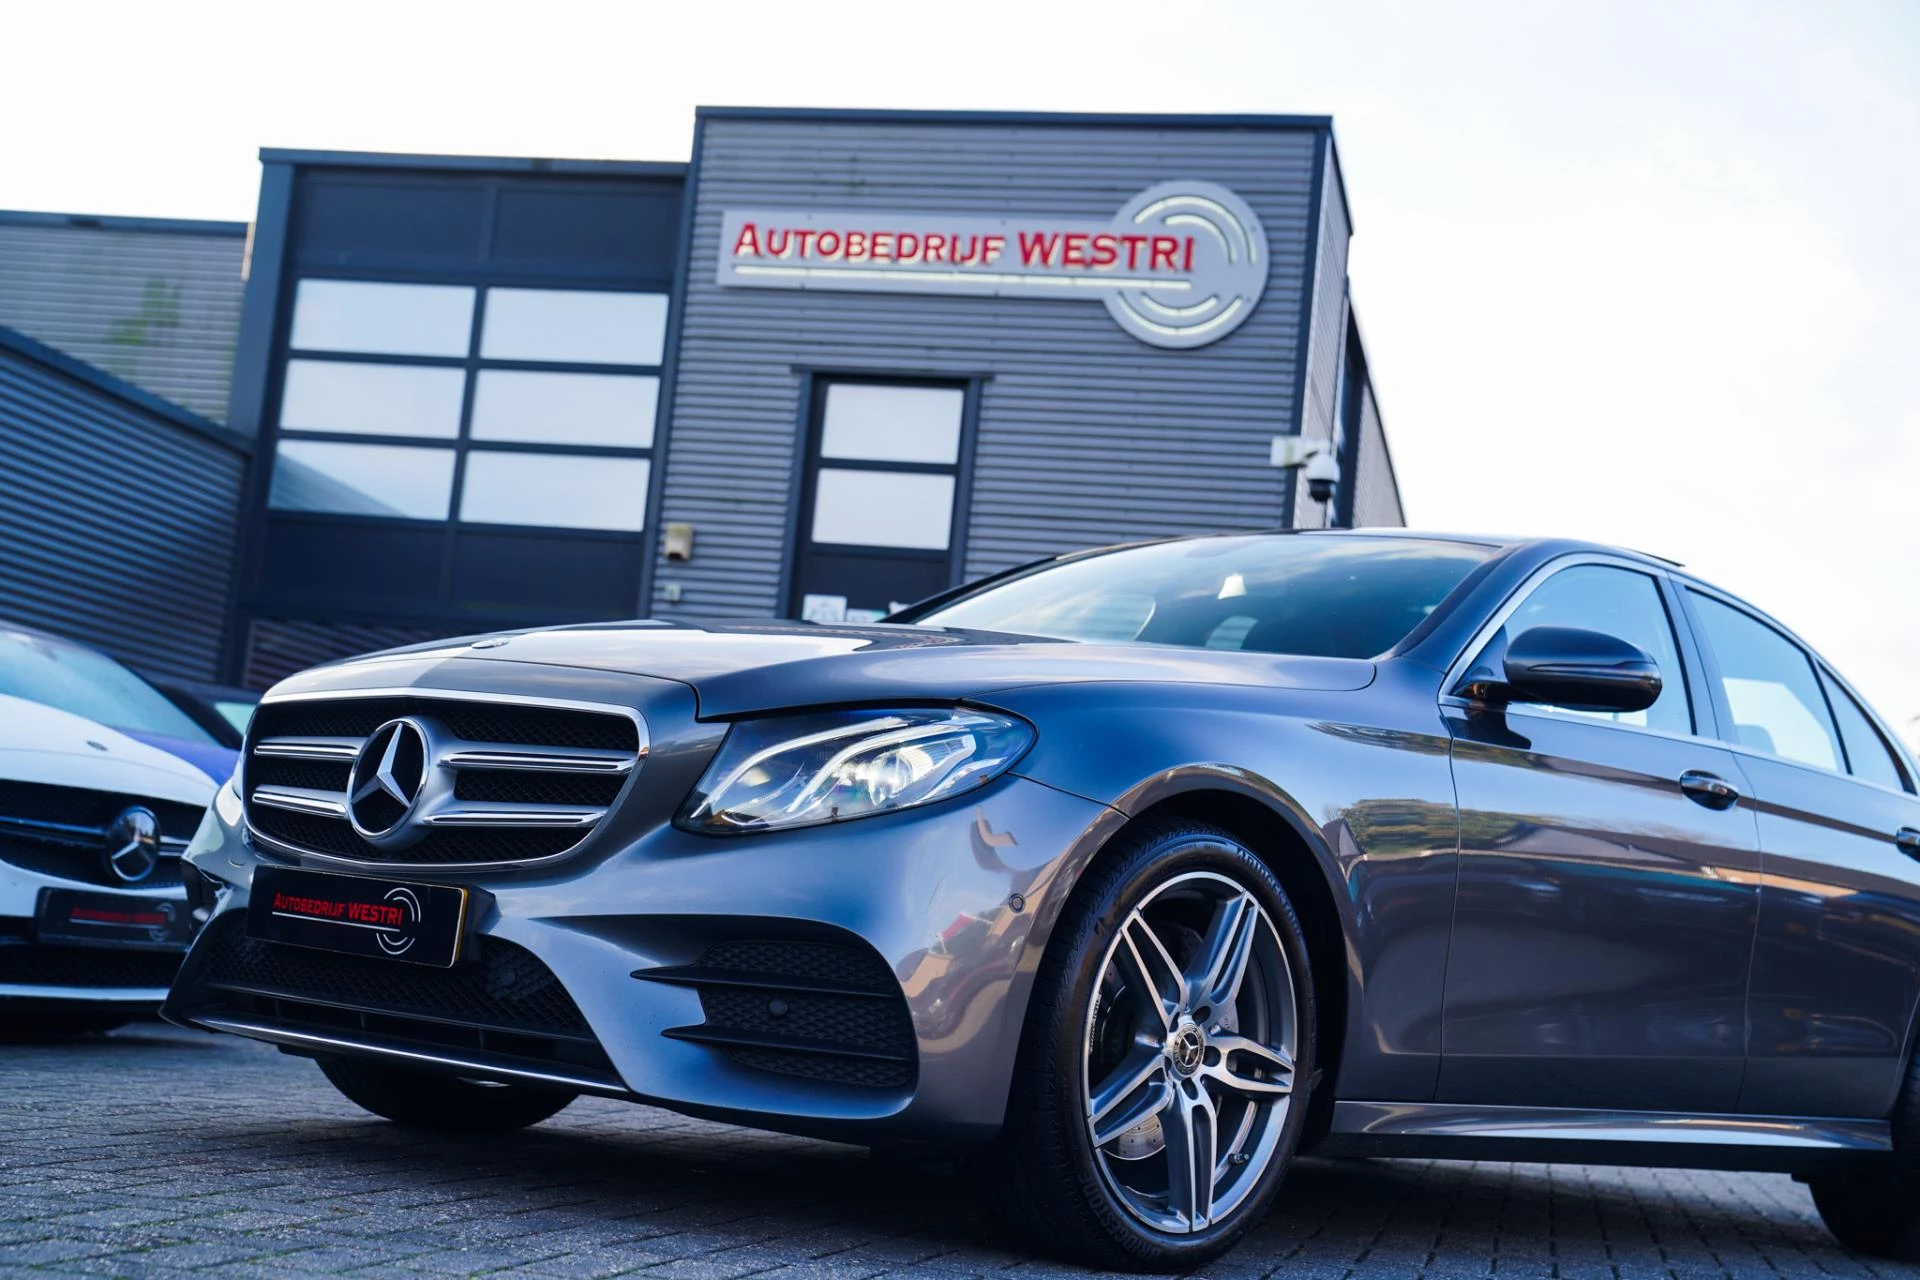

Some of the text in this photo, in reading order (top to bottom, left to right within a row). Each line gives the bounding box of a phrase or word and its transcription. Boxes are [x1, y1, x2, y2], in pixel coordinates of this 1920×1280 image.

[734, 222, 1195, 271] AUTOBEDRIJF WESTRI
[273, 892, 404, 925] AUTOBEDRIJF WESTRI
